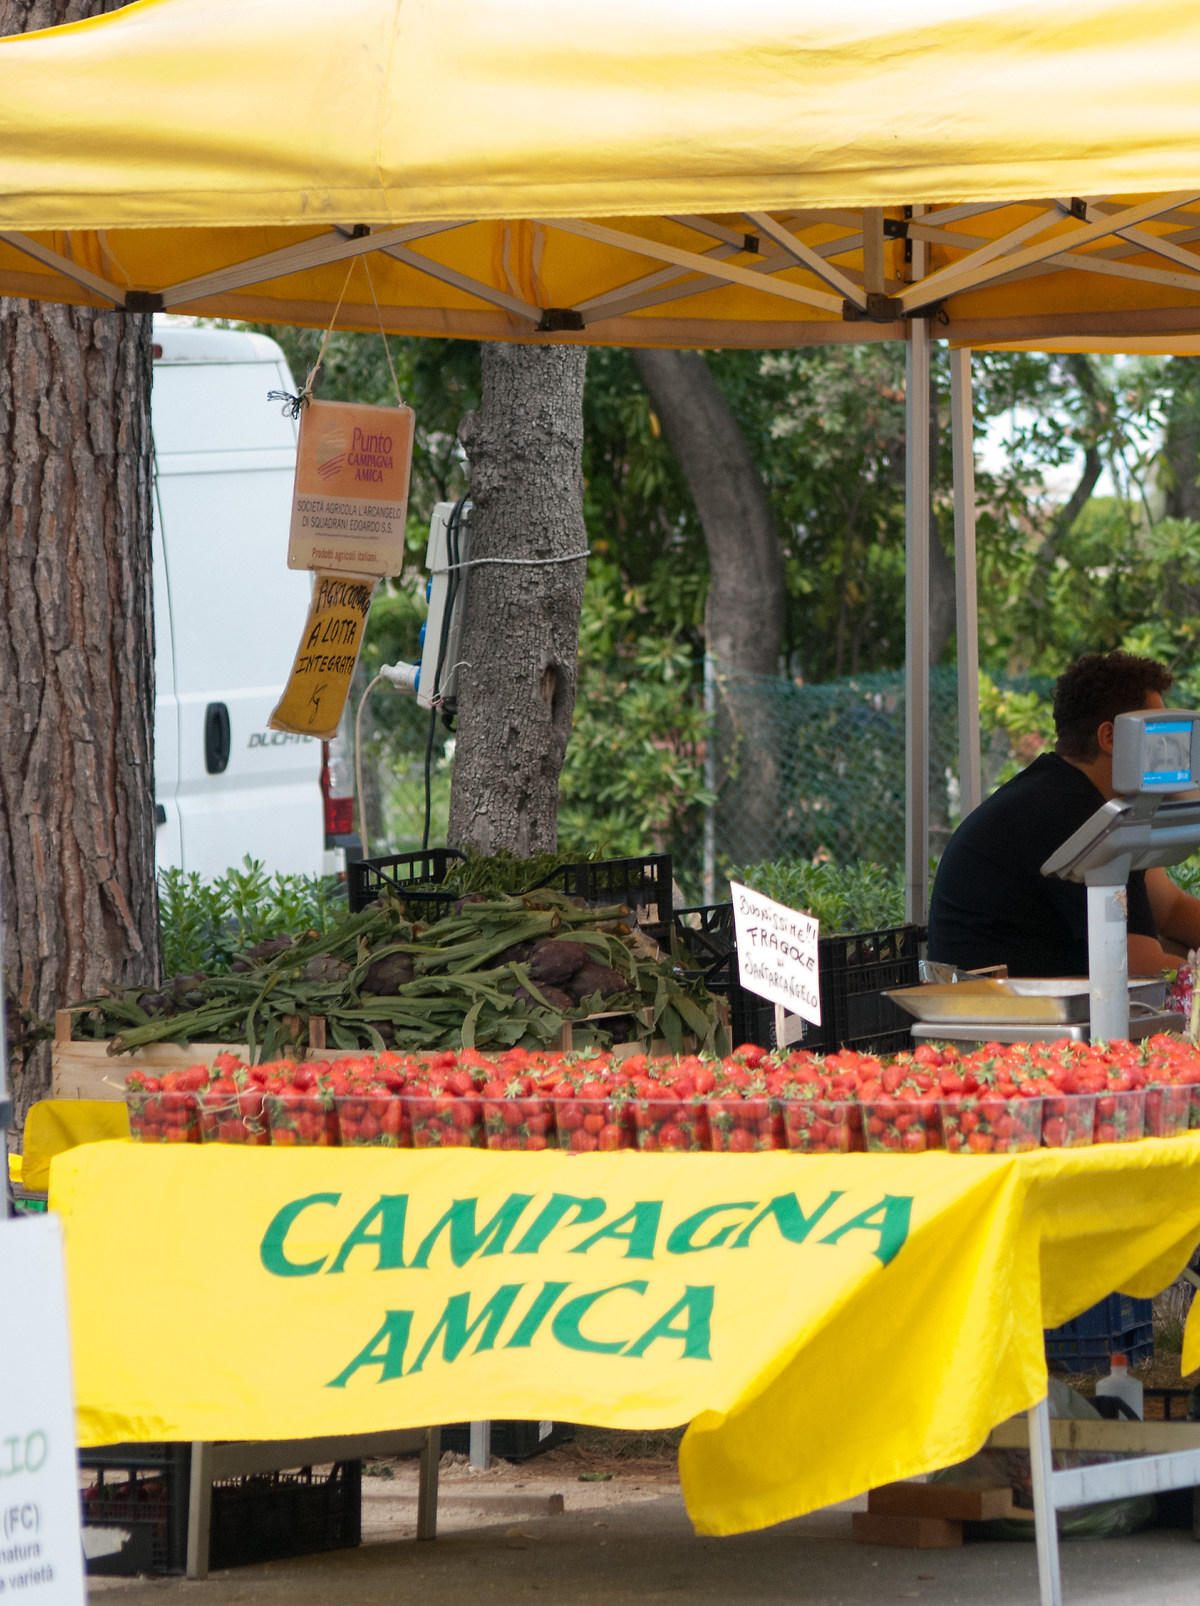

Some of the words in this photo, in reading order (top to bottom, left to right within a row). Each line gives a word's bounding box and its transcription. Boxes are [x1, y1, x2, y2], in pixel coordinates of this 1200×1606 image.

[351, 427, 393, 455] Punto
[347, 453, 393, 469] CAMPAGNA
[354, 469, 383, 482] AMICA
[297, 500, 324, 513] SOCIETÀ
[326, 502, 357, 516] AGRICOLA
[358, 505, 402, 519] L'ARCANGELO
[302, 515, 310, 528] DI
[311, 516, 347, 530] SQUADRANI
[349, 519, 380, 533] EDOARDO
[312, 547, 334, 560] Prodotti
[334, 551, 356, 563] agricoli
[306, 622, 322, 650] A
[322, 617, 357, 647] LOTTA
[296, 655, 355, 675] INTEGRATA
[746, 927, 816, 972] FRAGOLE
[259, 1191, 914, 1278] CAMPAGNA
[323, 1279, 716, 1388] AMICA
[3, 1503, 41, 1540] (FC)
[8, 1562, 54, 1591] varietà
